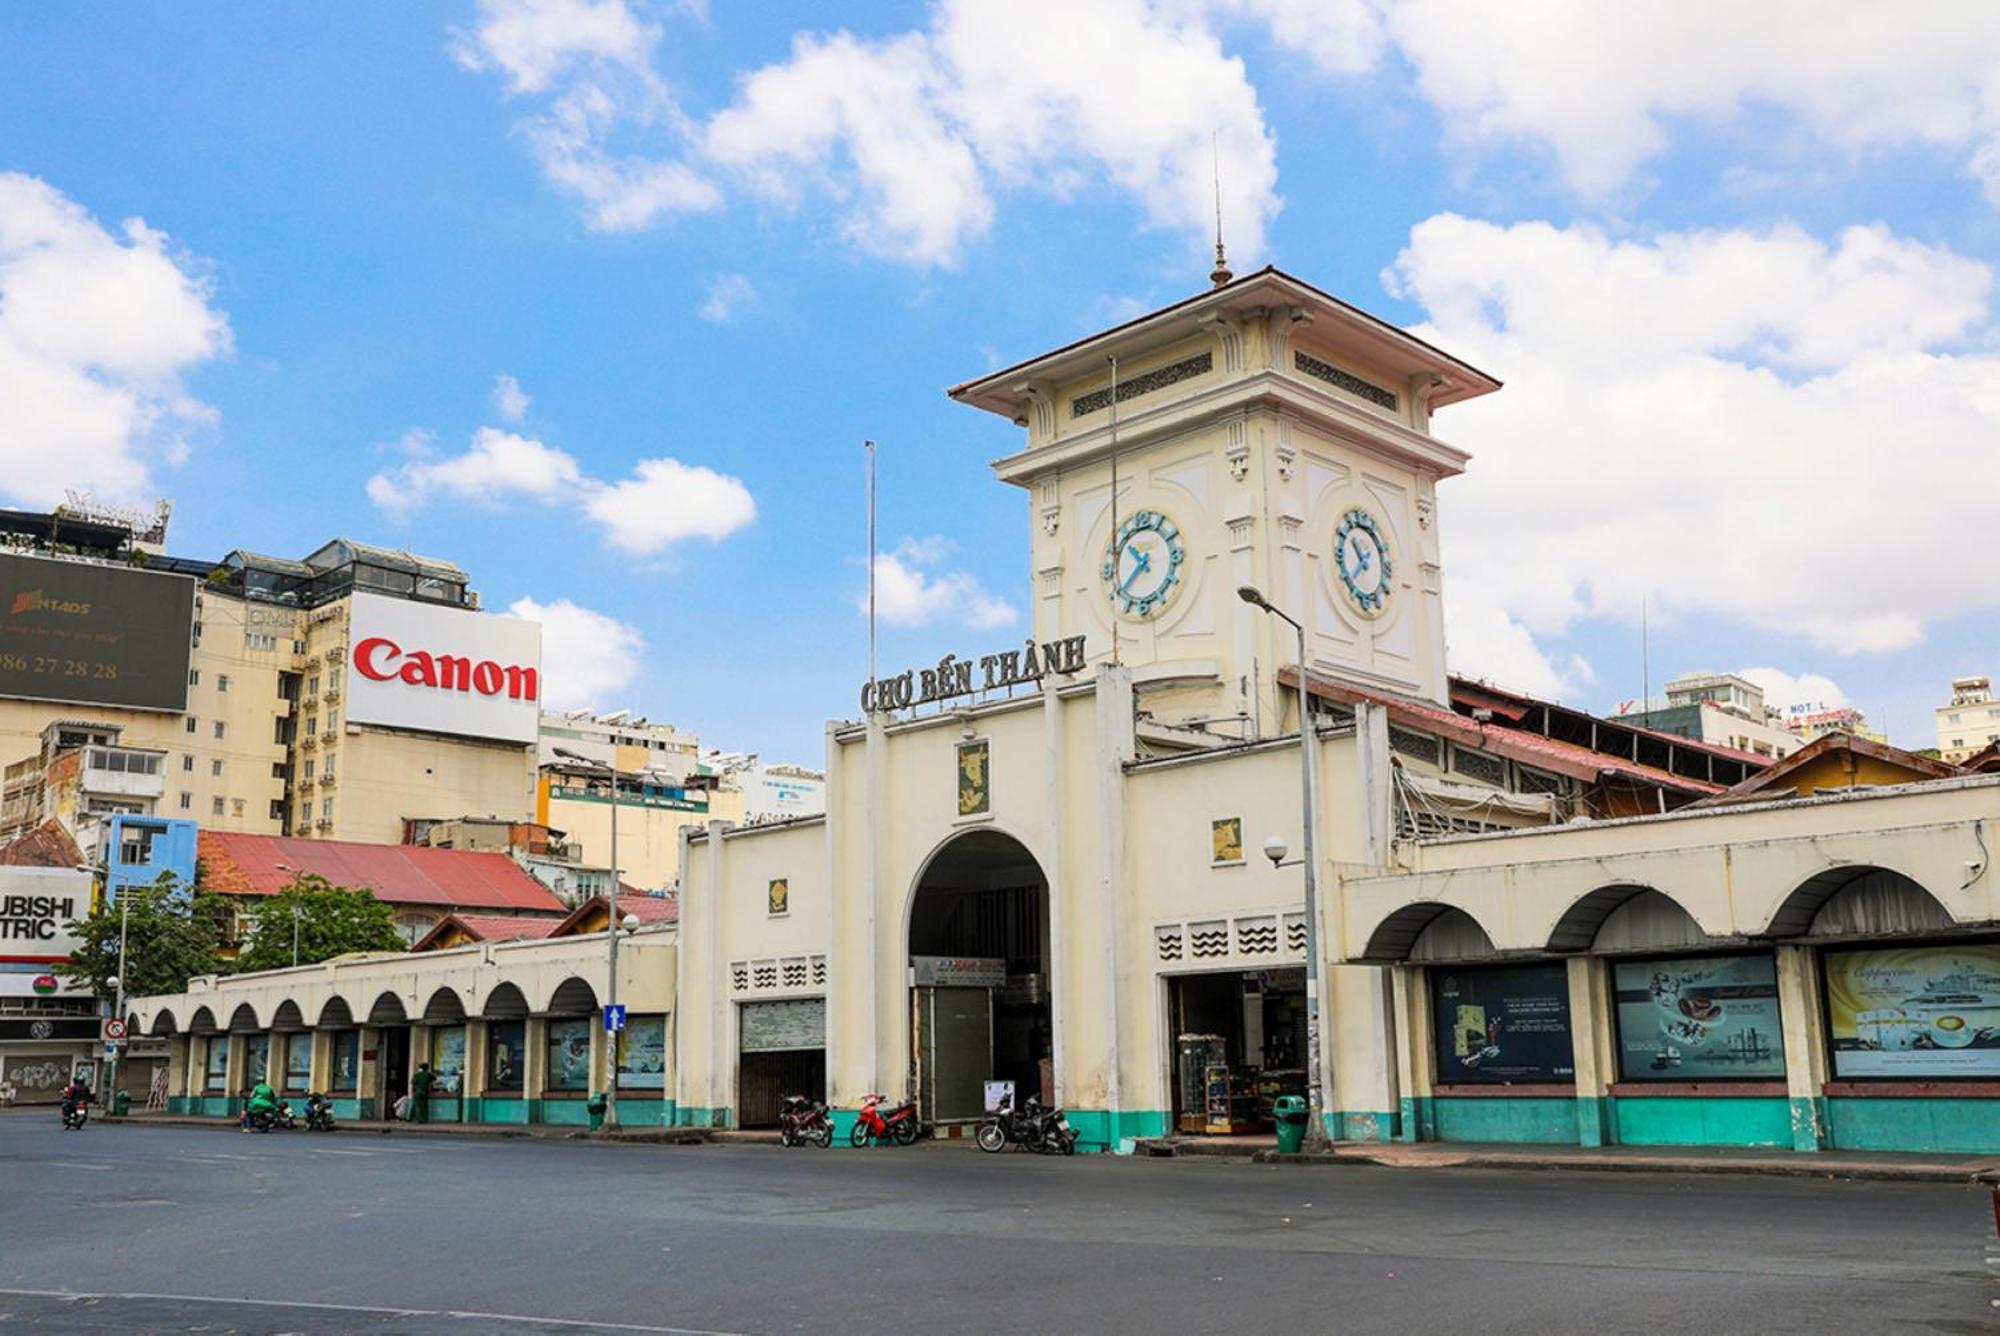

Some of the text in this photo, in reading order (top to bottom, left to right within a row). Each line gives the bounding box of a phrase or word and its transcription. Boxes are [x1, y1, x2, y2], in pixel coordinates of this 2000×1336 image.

[33, 656, 59, 673] 27
[64, 660, 88, 677] 28
[95, 663, 118, 680] 28
[353, 637, 537, 702] Canon
[919, 654, 973, 700] BẾN
